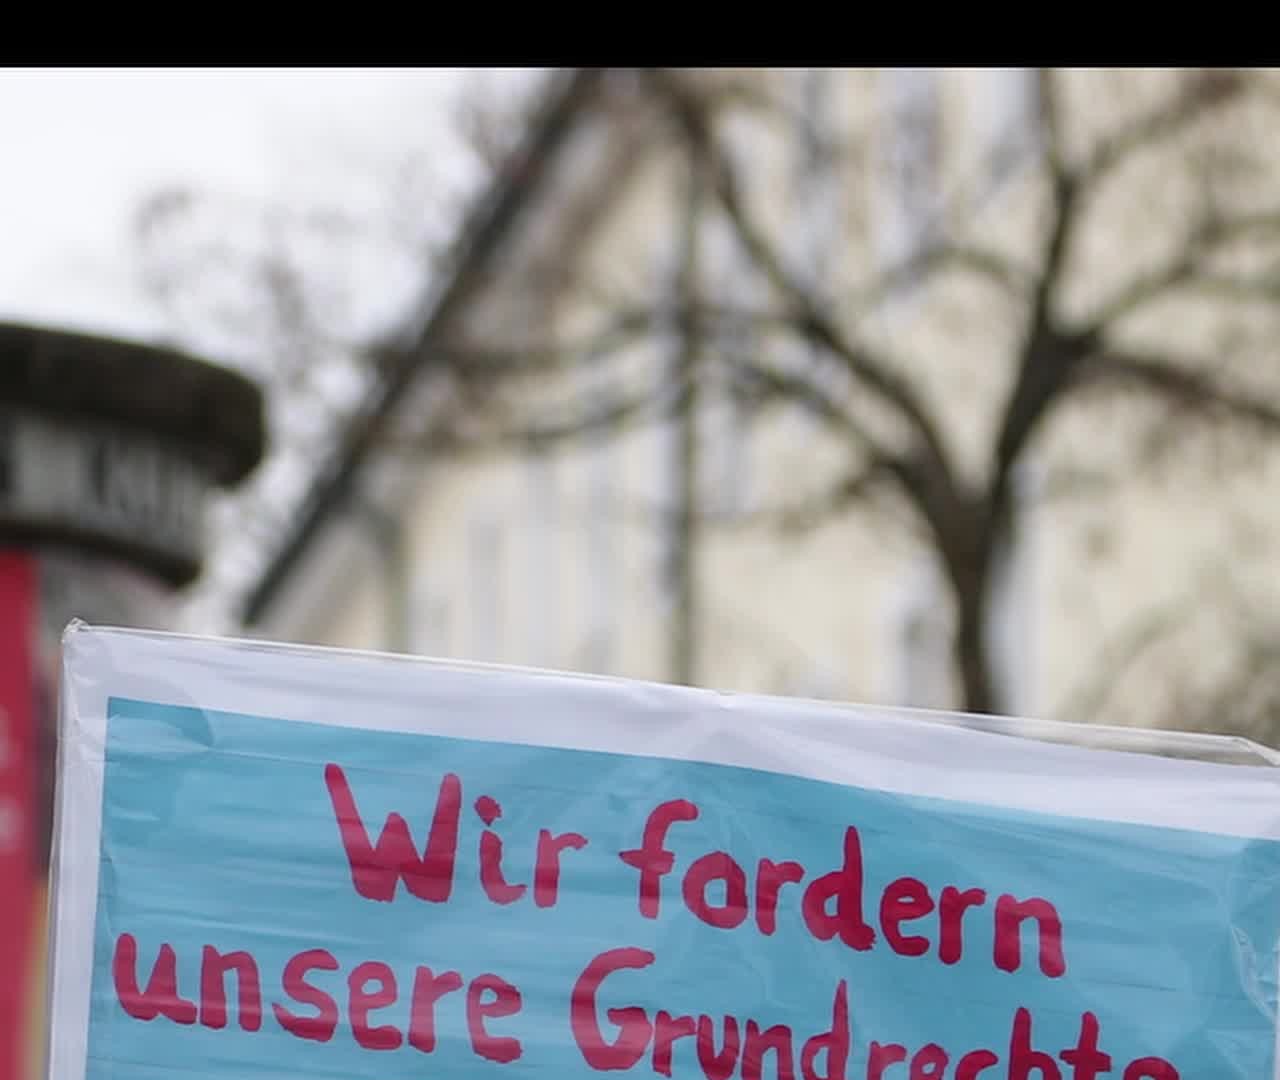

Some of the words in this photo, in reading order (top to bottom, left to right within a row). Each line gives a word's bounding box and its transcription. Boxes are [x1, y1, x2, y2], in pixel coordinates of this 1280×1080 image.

[324, 763, 588, 906] Wir
[620, 799, 1065, 978] fordern
[112, 933, 522, 1063] unsere
